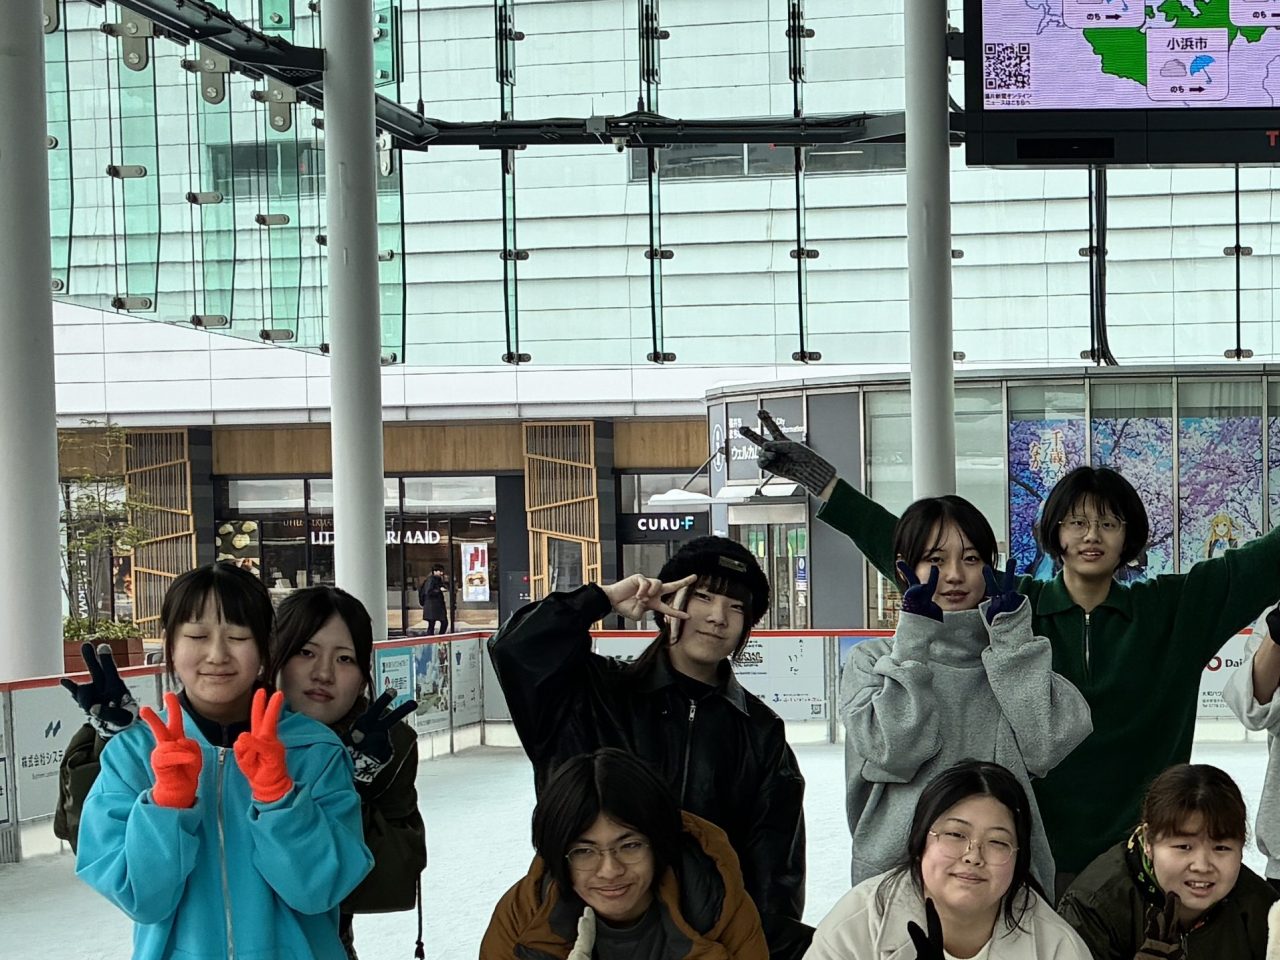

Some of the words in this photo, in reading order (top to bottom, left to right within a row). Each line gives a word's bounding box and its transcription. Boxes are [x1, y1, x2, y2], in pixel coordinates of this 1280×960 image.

[1167, 37, 1209, 50] 小浜市
[386, 531, 441, 545] RMAID
